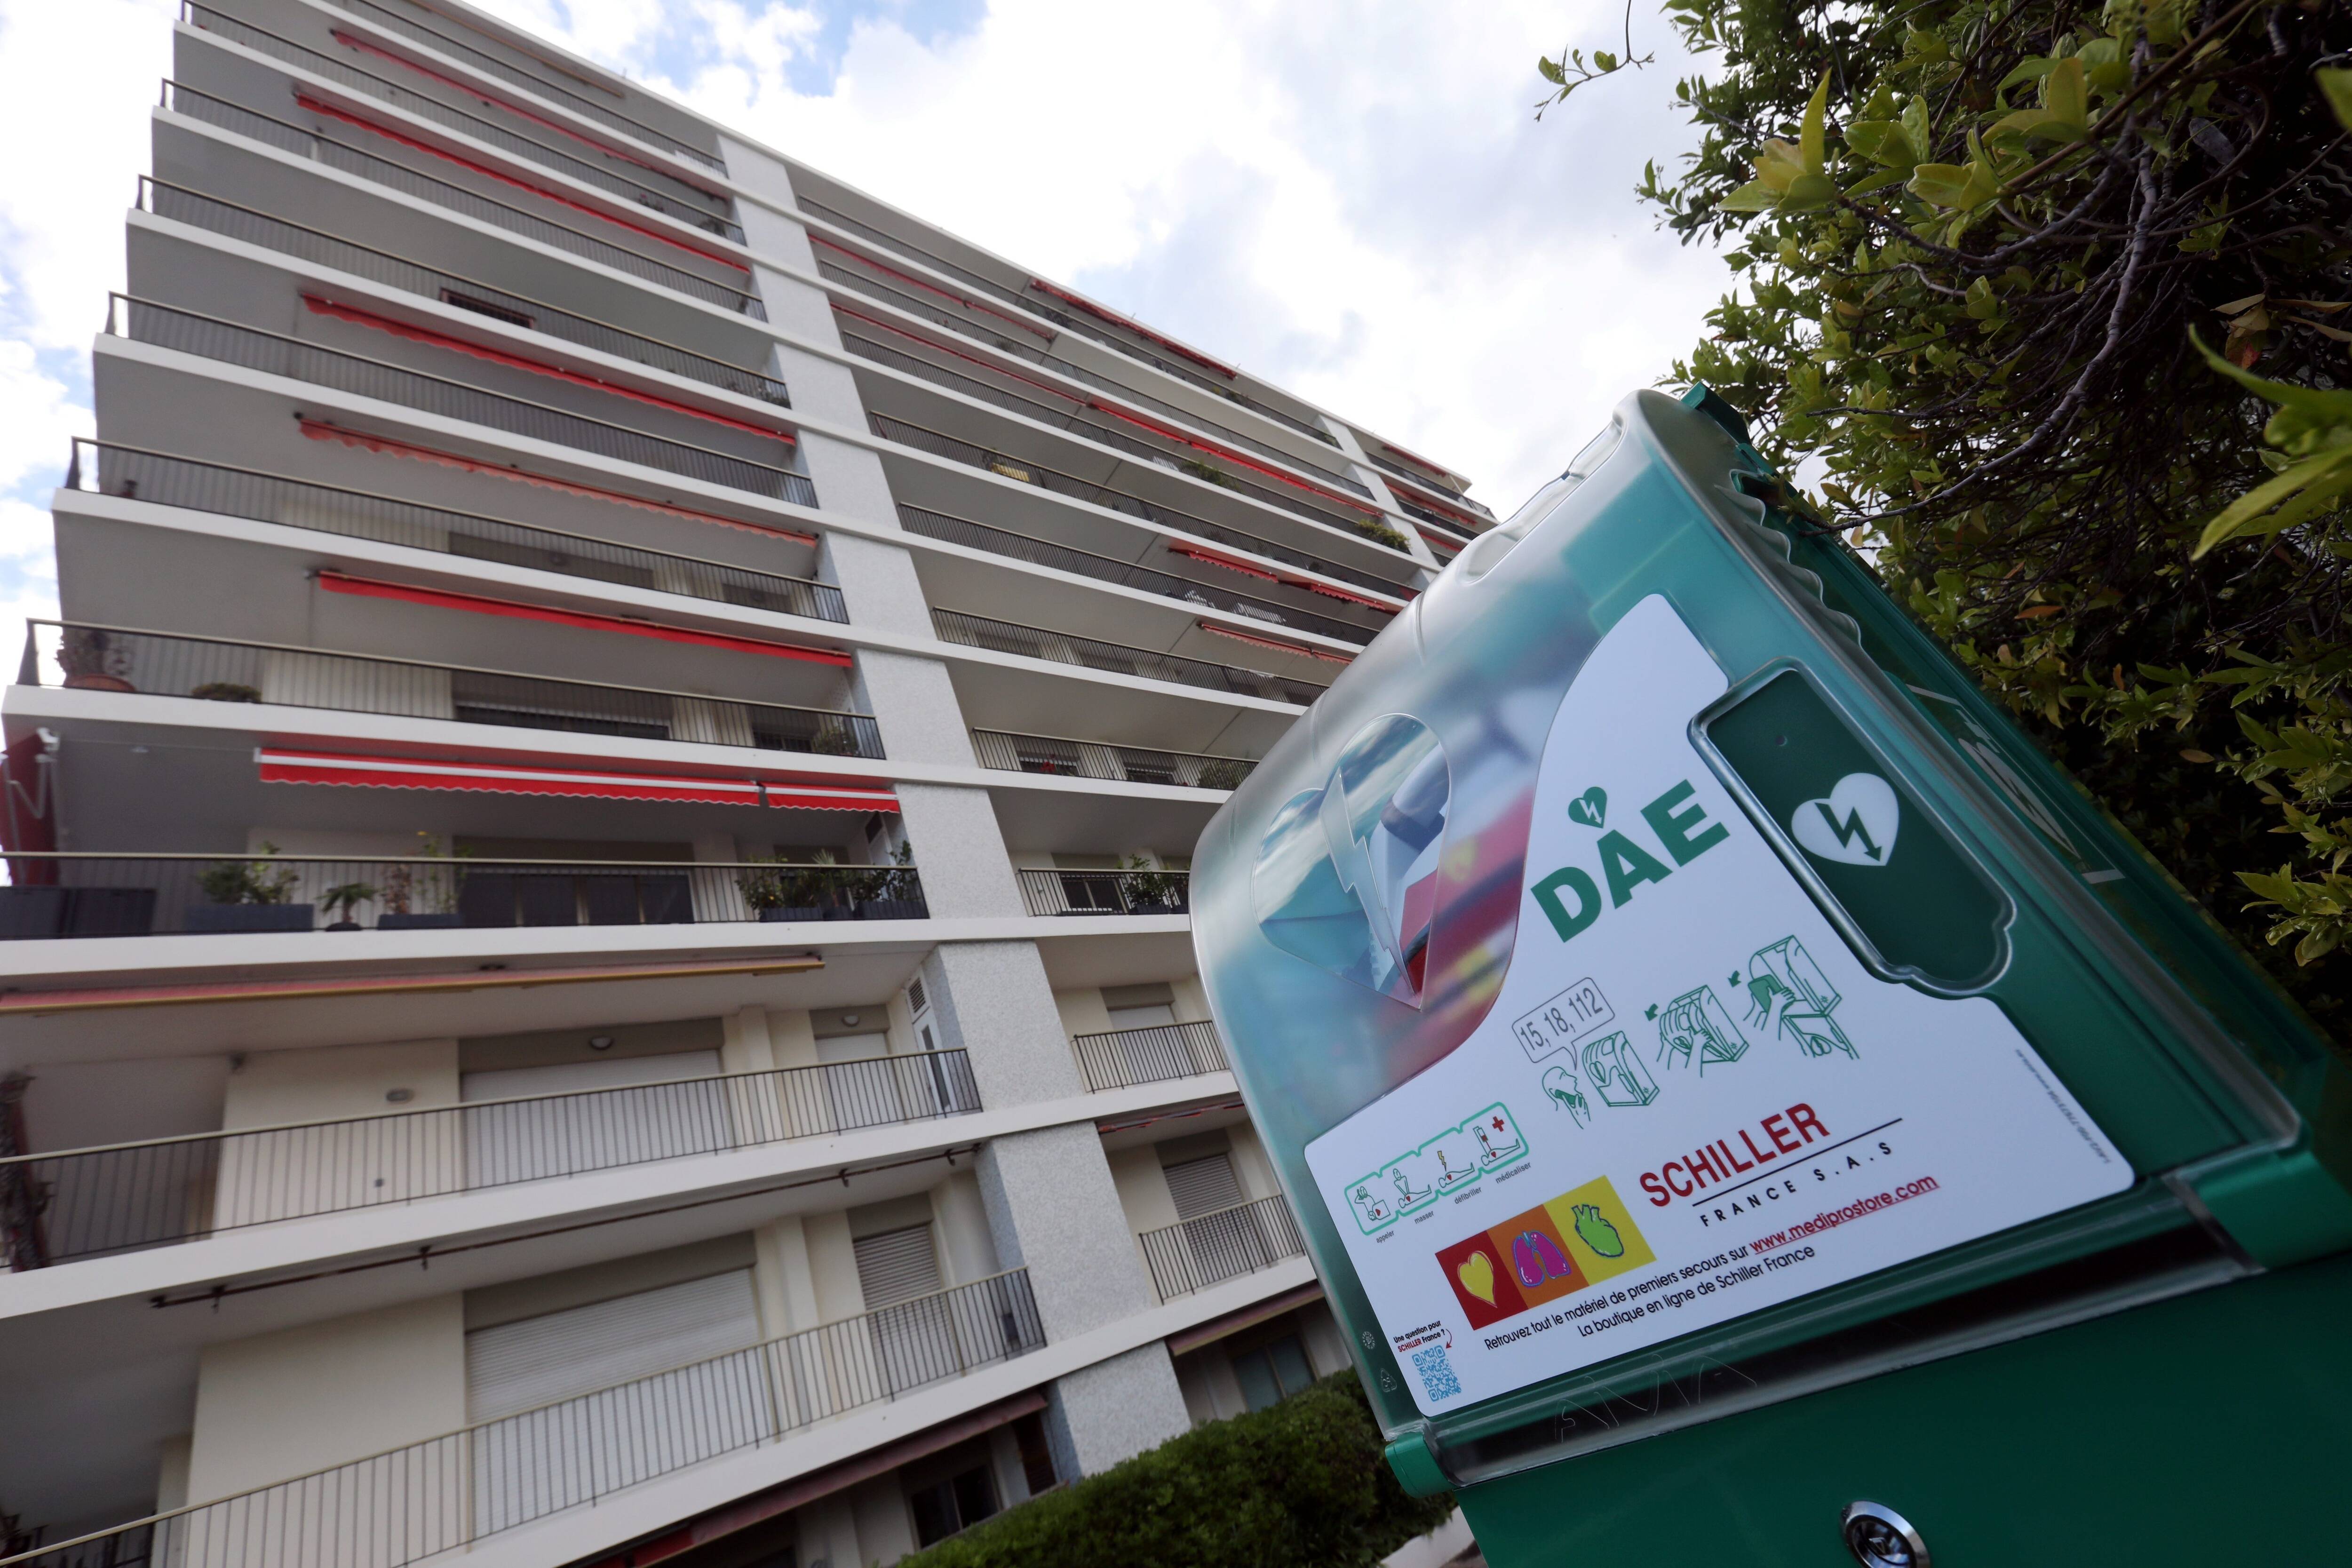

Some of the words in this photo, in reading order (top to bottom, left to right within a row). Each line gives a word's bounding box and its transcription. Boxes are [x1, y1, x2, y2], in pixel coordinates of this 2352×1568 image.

[1530, 779, 1731, 943] DAE
[1520, 1021, 1551, 1051] 15,
[1544, 1007, 1576, 1036] 18,
[1569, 987, 1603, 1022] 112
[1495, 1162, 1532, 1184] médicaliser
[1640, 1103, 1830, 1208] SCHILLER
[1454, 1186, 1482, 1205] défibriller
[1700, 1179, 1796, 1227] FRANCE
[1414, 1210, 1434, 1225] masser
[1376, 1230, 1395, 1243] appeler
[1484, 1325, 1532, 1351] Retrouvez
[1531, 1314, 1553, 1332] tout
[1550, 1311, 1564, 1326] le
[1564, 1295, 1610, 1322] matériel
[1610, 1287, 1627, 1305] de
[1627, 1271, 1678, 1301] premiers
[1679, 1252, 1729, 1280] secours
[1731, 1245, 1749, 1261] sur
[1749, 1175, 1939, 1255] www.mediprostore.com
[1577, 1324, 1594, 1337] La
[1594, 1305, 1645, 1332] boutique
[1646, 1298, 1664, 1313] en
[1662, 1288, 1696, 1308] ligne
[1697, 1278, 1716, 1296] de
[1718, 1264, 1765, 1289] Schiller
[1763, 1245, 1816, 1272] France
[1398, 1338, 1422, 1353] SCHILLER
[1422, 1331, 1441, 1344] France
[1405, 1326, 1428, 1339] question
[1428, 1320, 1441, 1331] pour
